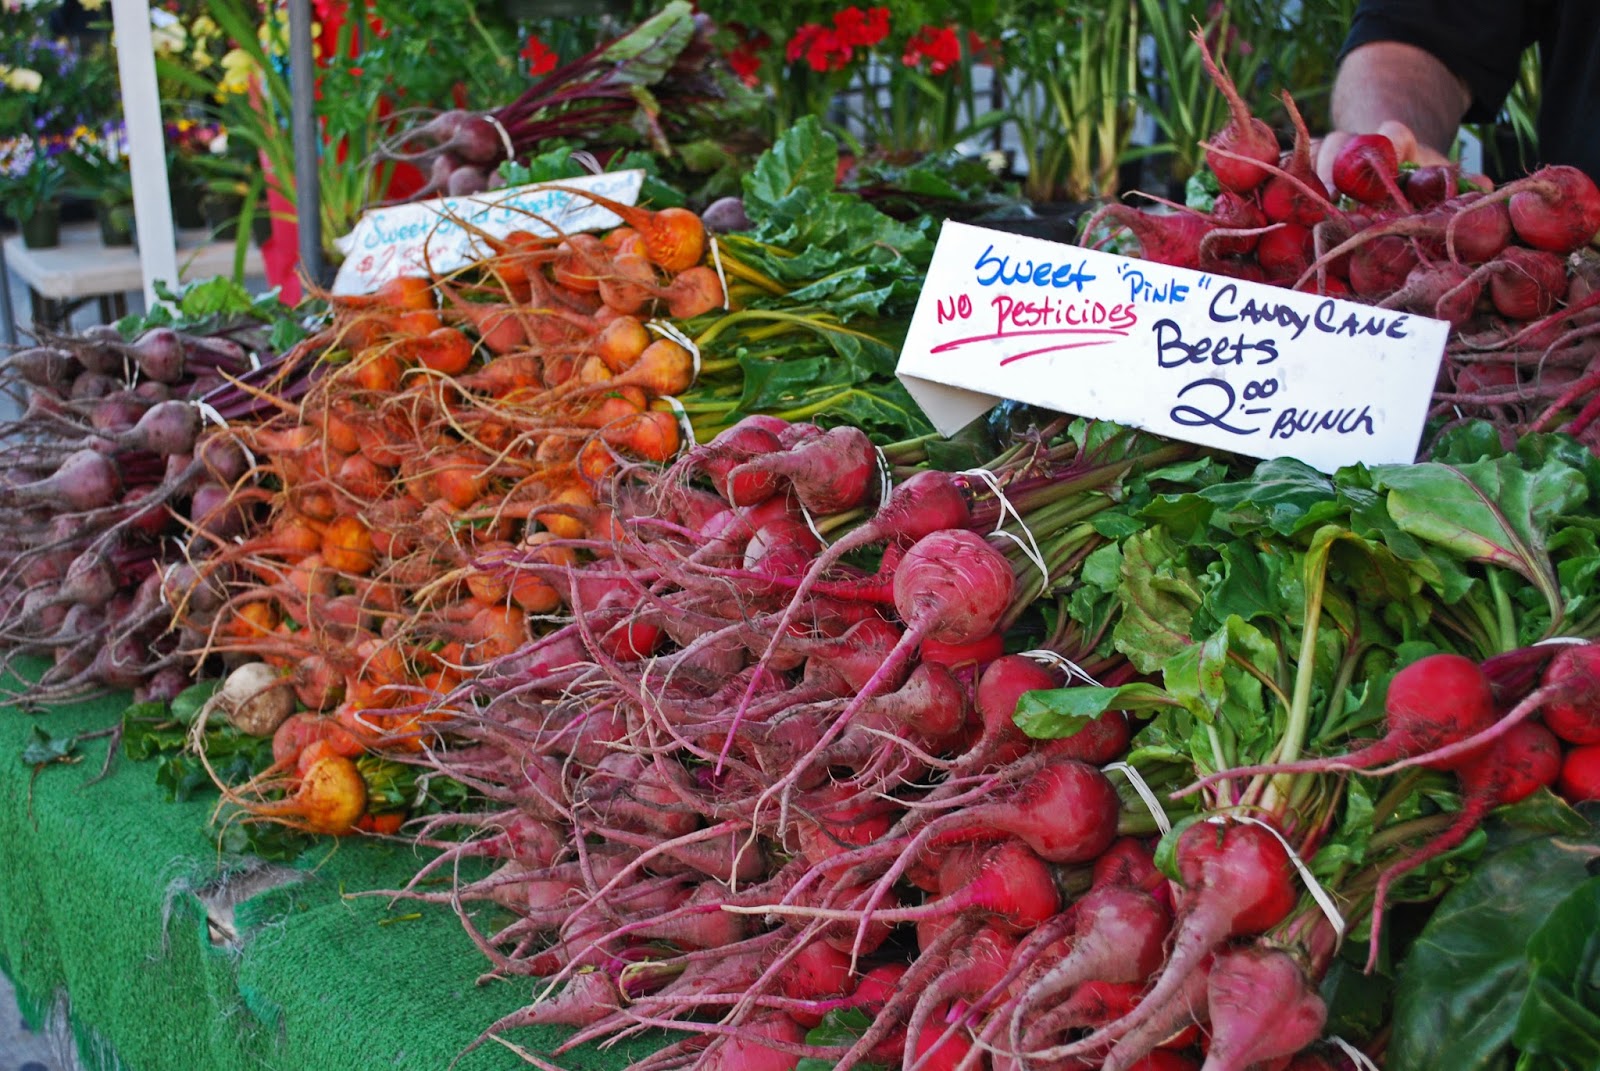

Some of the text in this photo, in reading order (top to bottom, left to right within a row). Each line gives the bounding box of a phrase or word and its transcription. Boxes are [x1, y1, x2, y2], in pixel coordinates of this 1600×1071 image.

[364, 214, 429, 249] Sweet
[974, 244, 1097, 293] Sweet
[937, 293, 973, 325] NO
[1151, 317, 1280, 369] Beets
